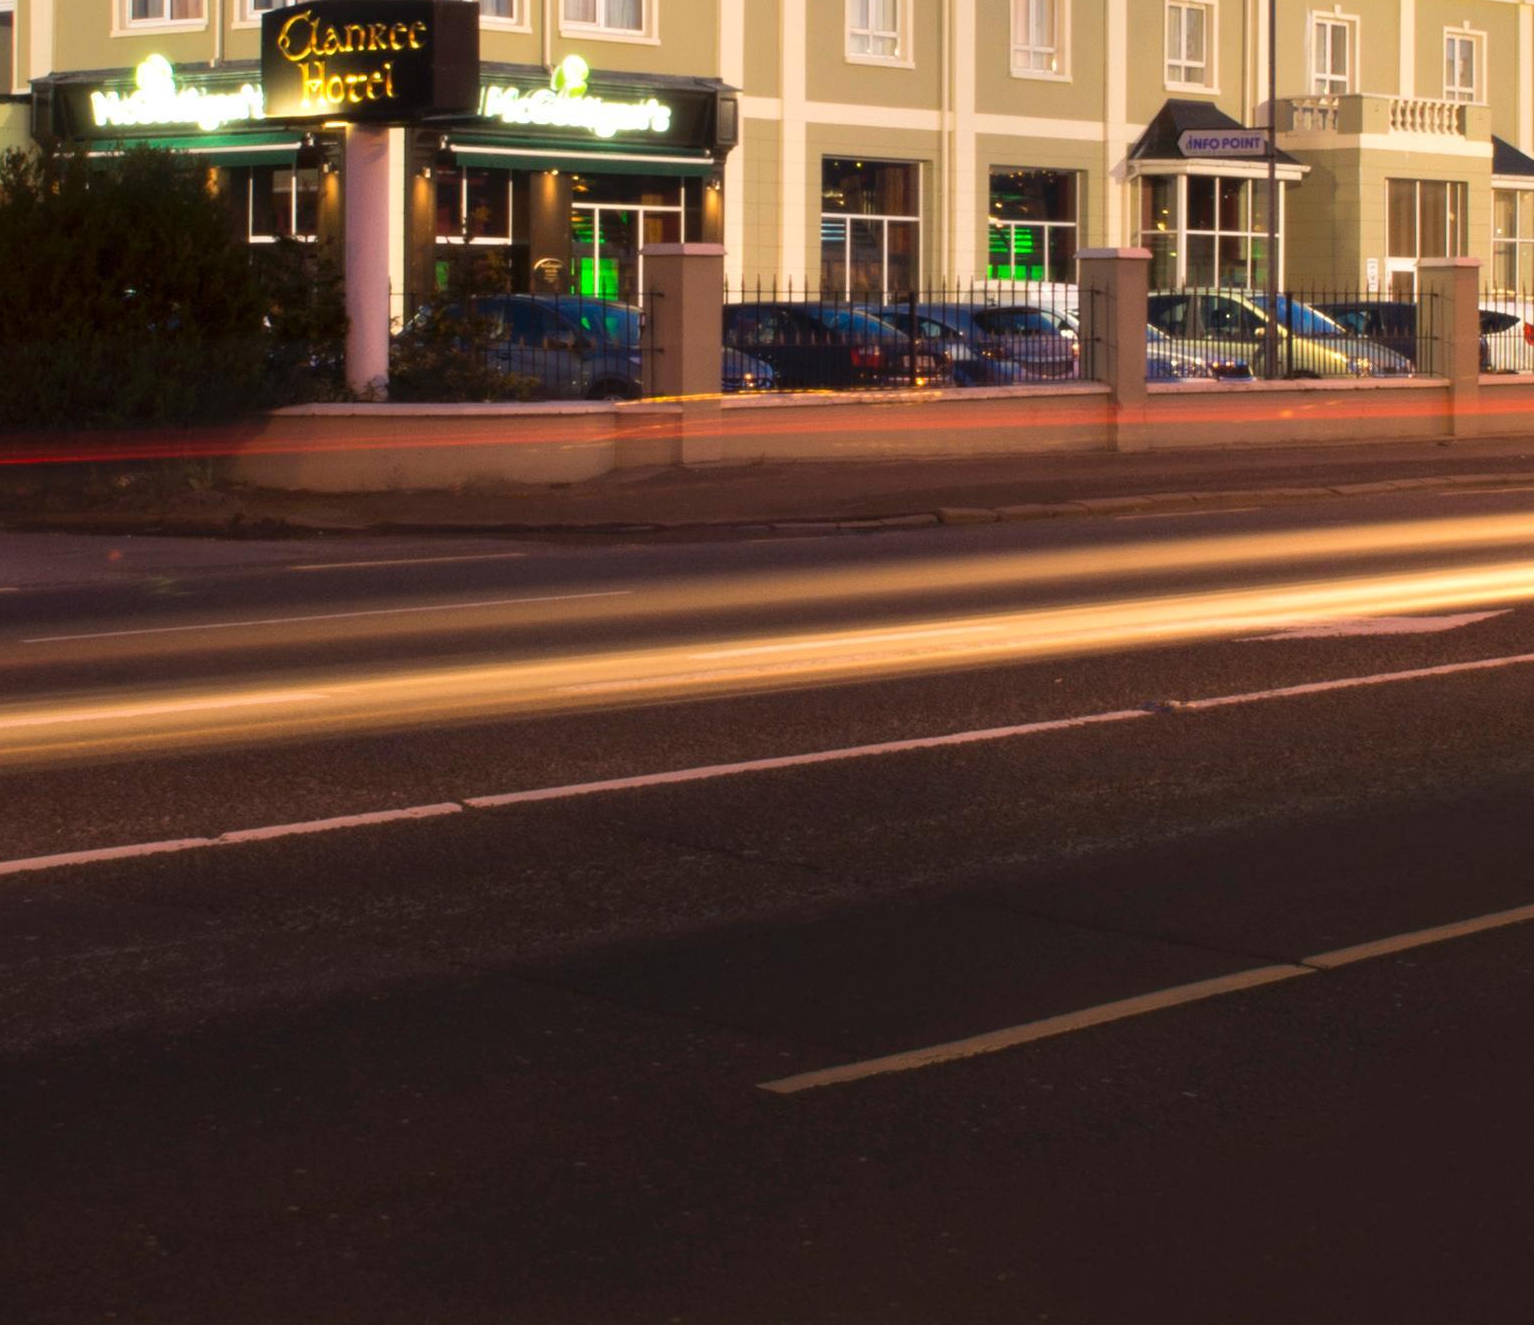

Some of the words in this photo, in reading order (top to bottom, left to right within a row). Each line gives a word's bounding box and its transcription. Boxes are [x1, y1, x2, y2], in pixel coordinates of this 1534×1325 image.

[297, 60, 397, 108] Hotel
[1188, 135, 1220, 150] INFO
[1222, 137, 1261, 150] POINT
